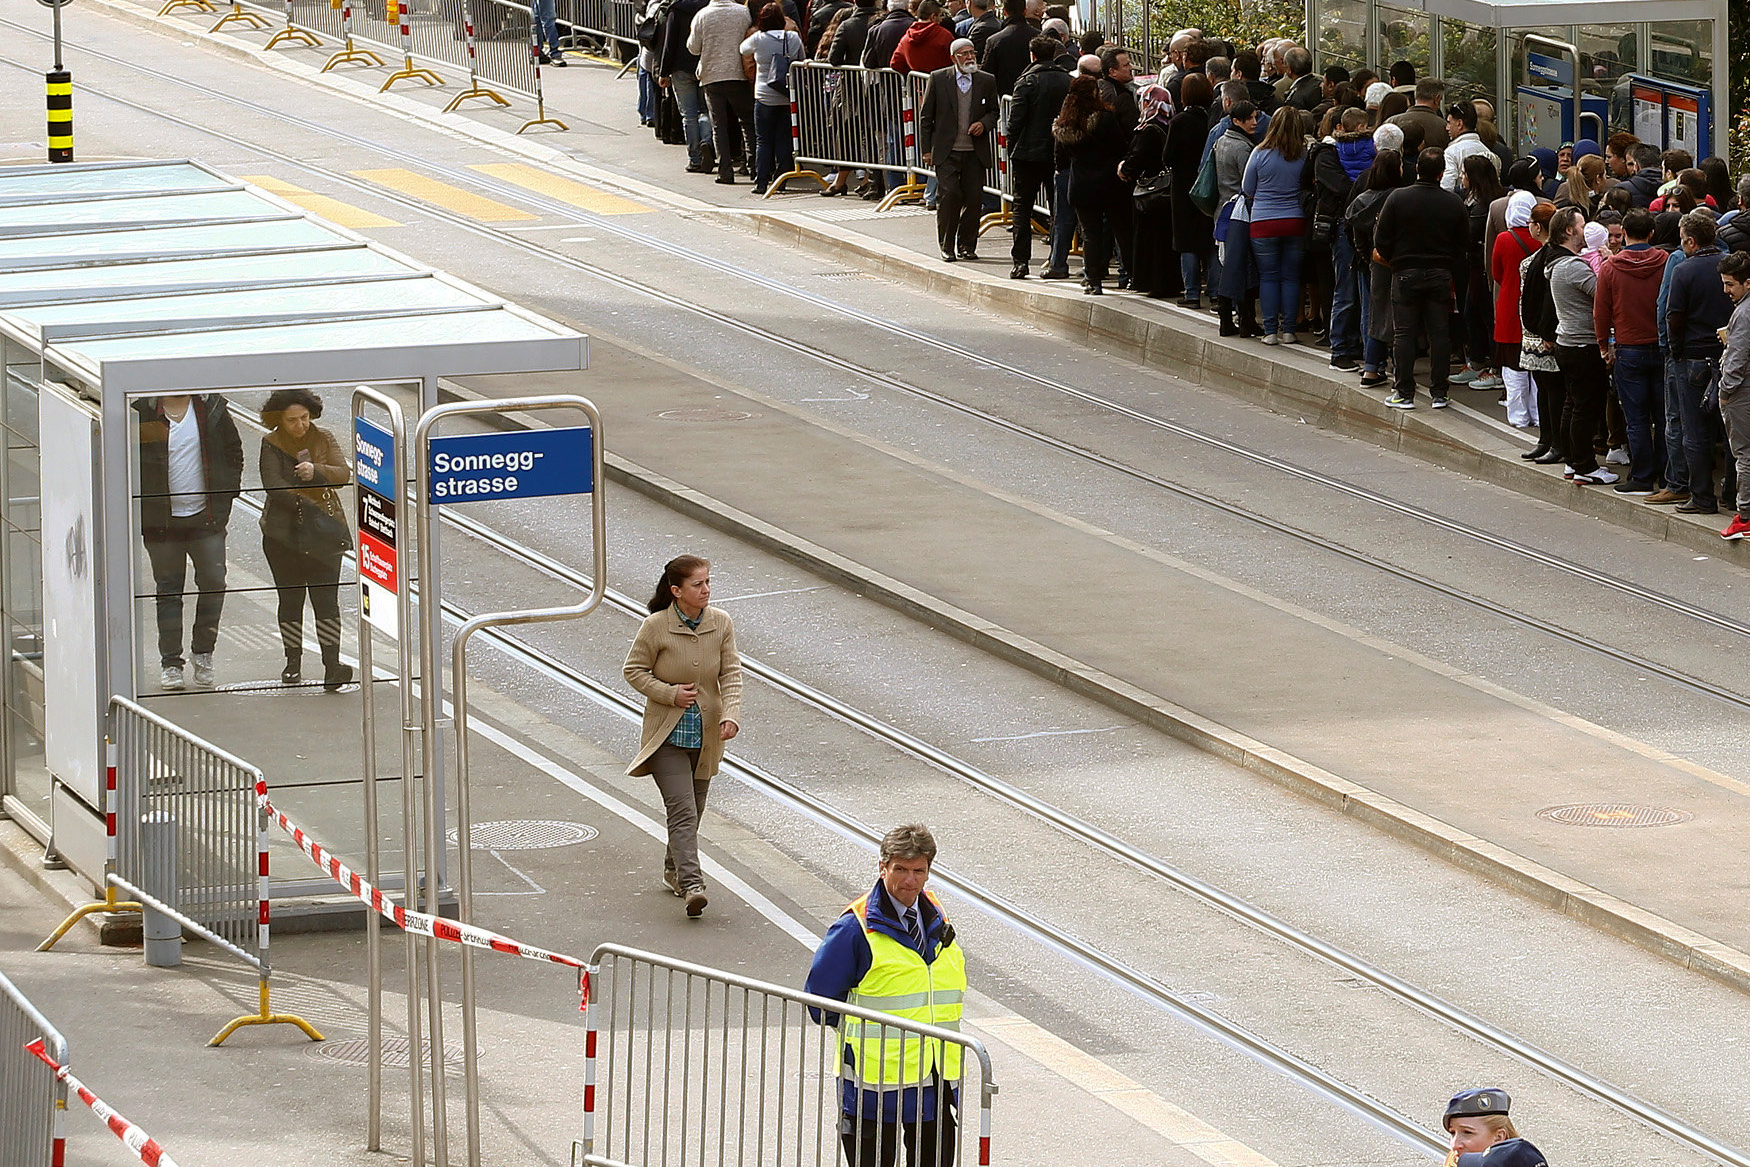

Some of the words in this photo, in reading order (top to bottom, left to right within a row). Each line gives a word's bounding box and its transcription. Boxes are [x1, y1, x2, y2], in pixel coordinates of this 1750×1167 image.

[357, 458, 379, 485] strasse
[434, 450, 544, 473] Sonnegg-
[435, 476, 518, 497] strasse
[362, 496, 369, 524] 7
[361, 542, 370, 570] 15
